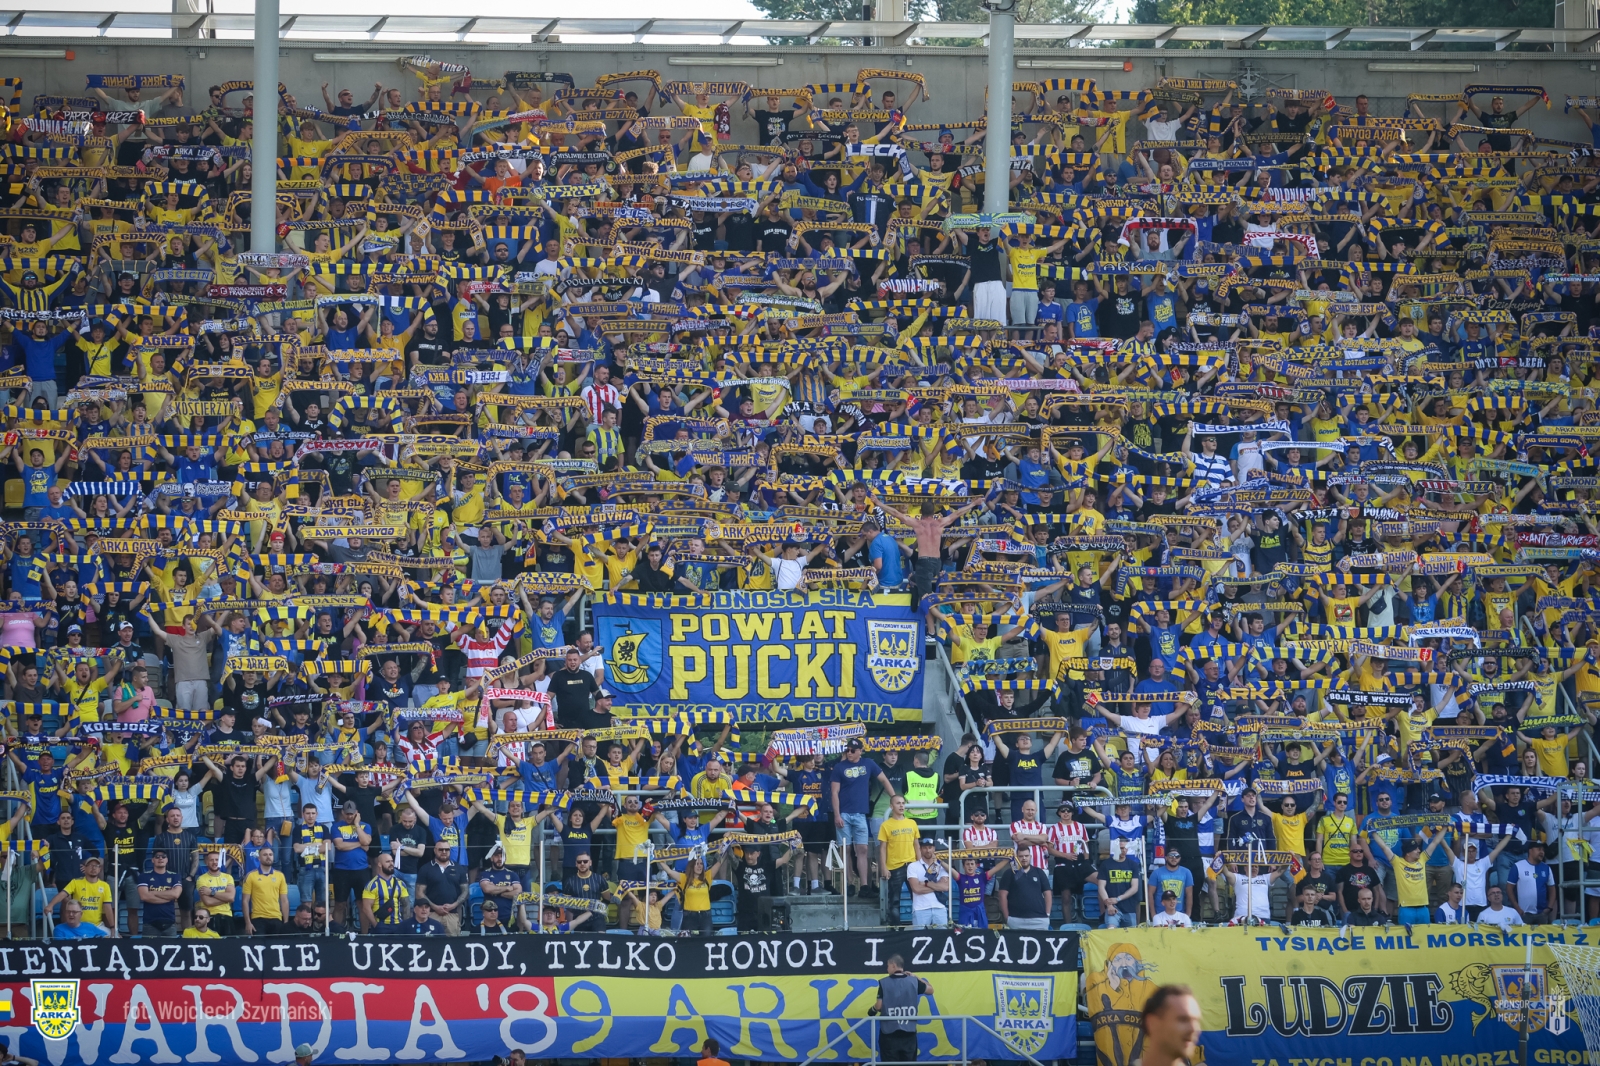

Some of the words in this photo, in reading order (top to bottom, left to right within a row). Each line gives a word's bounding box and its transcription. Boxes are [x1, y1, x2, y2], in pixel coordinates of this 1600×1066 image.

[559, 88, 615, 98] ULTRAS
[821, 111, 847, 120] ARKA
[851, 111, 889, 120] GDYNIA
[848, 144, 901, 156] LECH
[472, 206, 542, 217] GDYNIA
[1139, 217, 1190, 229] ARKA
[653, 249, 691, 261] GDYNIA
[1198, 422, 1239, 434] LECH
[305, 439, 379, 450] CRACOVIA
[1236, 491, 1264, 501] ARKA
[1270, 489, 1311, 499] GDYNIA
[557, 514, 588, 526] ARKA
[591, 512, 633, 523] GDYNIA
[723, 527, 750, 538] ARKA
[101, 541, 129, 553] ARKA
[806, 568, 834, 580] ARKA
[836, 568, 872, 578] GDYNIA
[820, 589, 875, 607] SIŁA
[669, 611, 856, 642] POWIAT
[1385, 646, 1418, 659] GDYNIA
[874, 658, 912, 668] ARKA
[669, 643, 857, 700] PUCKI
[494, 688, 542, 701] CRACOVIA
[804, 702, 895, 724] GDYNIA
[83, 722, 160, 734] KOLEJORZ
[658, 799, 688, 809] STARA
[690, 797, 722, 808] RUMIA
[1255, 936, 1365, 955] TYSIĄCE
[1374, 935, 1419, 950] MIL
[1427, 932, 1566, 948] MORSKICH
[1571, 932, 1589, 946] Z
[243, 943, 320, 972] NIE
[349, 942, 527, 975] UKŁADY,
[546, 940, 676, 972] TYLKO
[704, 938, 836, 971] HONOR
[863, 938, 885, 967] I
[911, 935, 1069, 966] ZASADY
[1219, 972, 1454, 1038] LUDZIE
[888, 1006, 917, 1018] FOTO
[1002, 1018, 1046, 1030] ARKA
[1096, 1014, 1120, 1026] ARKA
